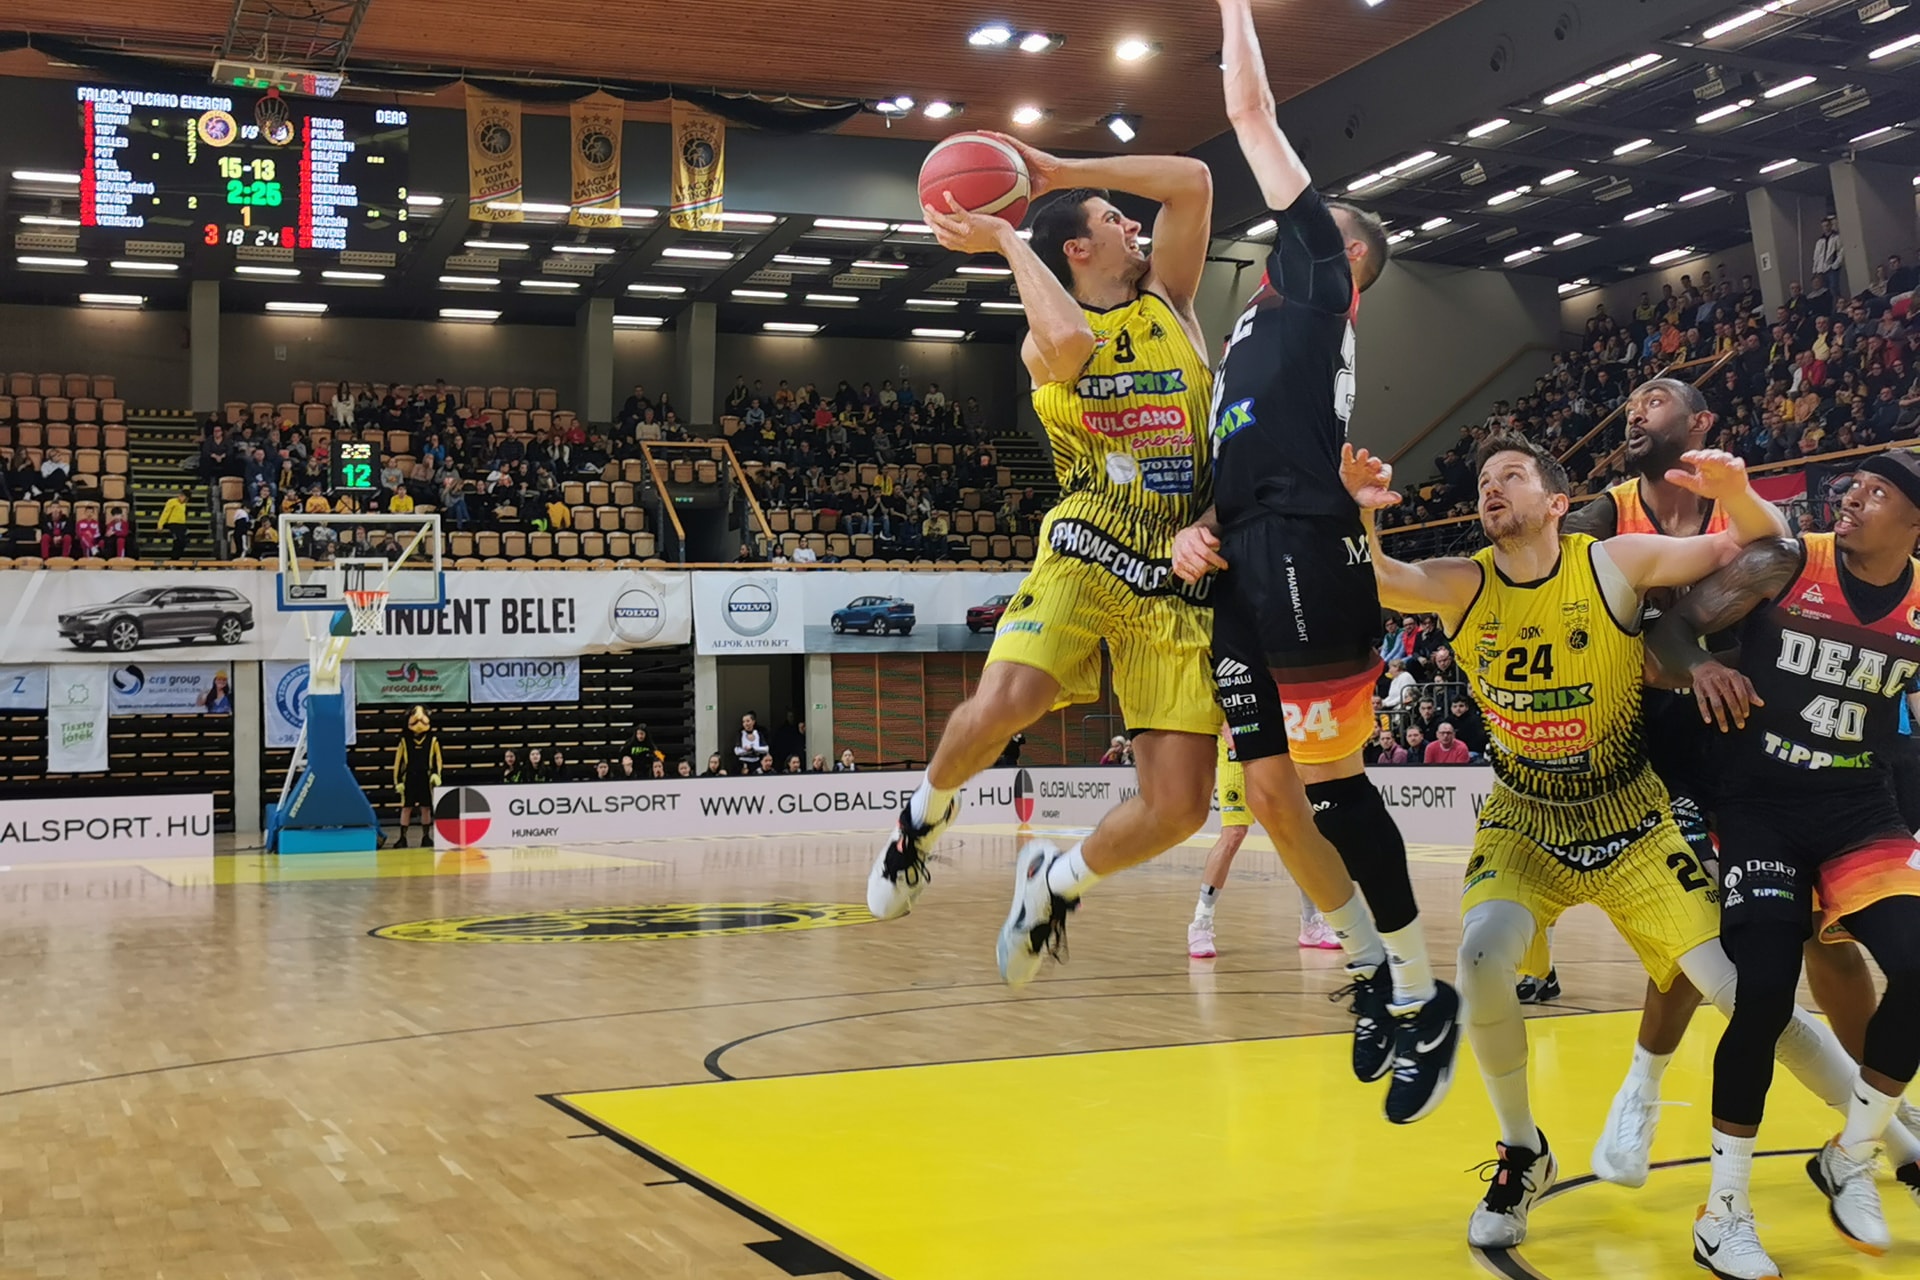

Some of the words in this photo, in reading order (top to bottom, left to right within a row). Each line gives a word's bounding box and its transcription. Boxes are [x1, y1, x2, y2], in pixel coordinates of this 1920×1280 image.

[77, 87, 178, 108] FALCO-VULCANO
[180, 95, 232, 111] ENERGIA
[375, 110, 407, 125] DEAC
[218, 156, 275, 181] 15-13
[577, 172, 618, 189] MAGYAR
[227, 180, 282, 206] 2:25
[398, 187, 407, 199] 3
[188, 197, 197, 209] 2
[240, 206, 251, 226] 1
[398, 209, 407, 221] 2
[204, 223, 218, 245] 3
[226, 229, 244, 245] 18
[255, 230, 279, 246] 24
[1114, 329, 1136, 363] 9
[1085, 410, 1182, 433] VULCANO
[1141, 460, 1192, 471] VOLVO
[342, 464, 371, 487] 12
[354, 598, 490, 635] INDENT
[502, 598, 576, 635] BELE!
[730, 603, 770, 611] VOLVO
[712, 640, 742, 648] ALPOK
[744, 639, 769, 648] AUTÓ
[1504, 644, 1554, 682] 24
[1776, 629, 1919, 698] DEAC
[149, 676, 166, 684] crs
[169, 675, 201, 686] group
[480, 661, 566, 685] pannon
[517, 676, 569, 692] sport
[1223, 693, 1256, 708] elta
[61, 721, 94, 734] Tiszta
[1281, 699, 1339, 742] 24
[1800, 694, 1868, 742] 40
[62, 730, 93, 746] játék
[1040, 781, 1111, 800] GLOBALSPORT
[509, 794, 681, 816] GLOBALSPORT
[699, 786, 1012, 816] WWW.GLOBALSP.HU
[512, 827, 559, 838] HUNGARY
[1666, 851, 1710, 893] 2
[1746, 859, 1796, 878] Delta
